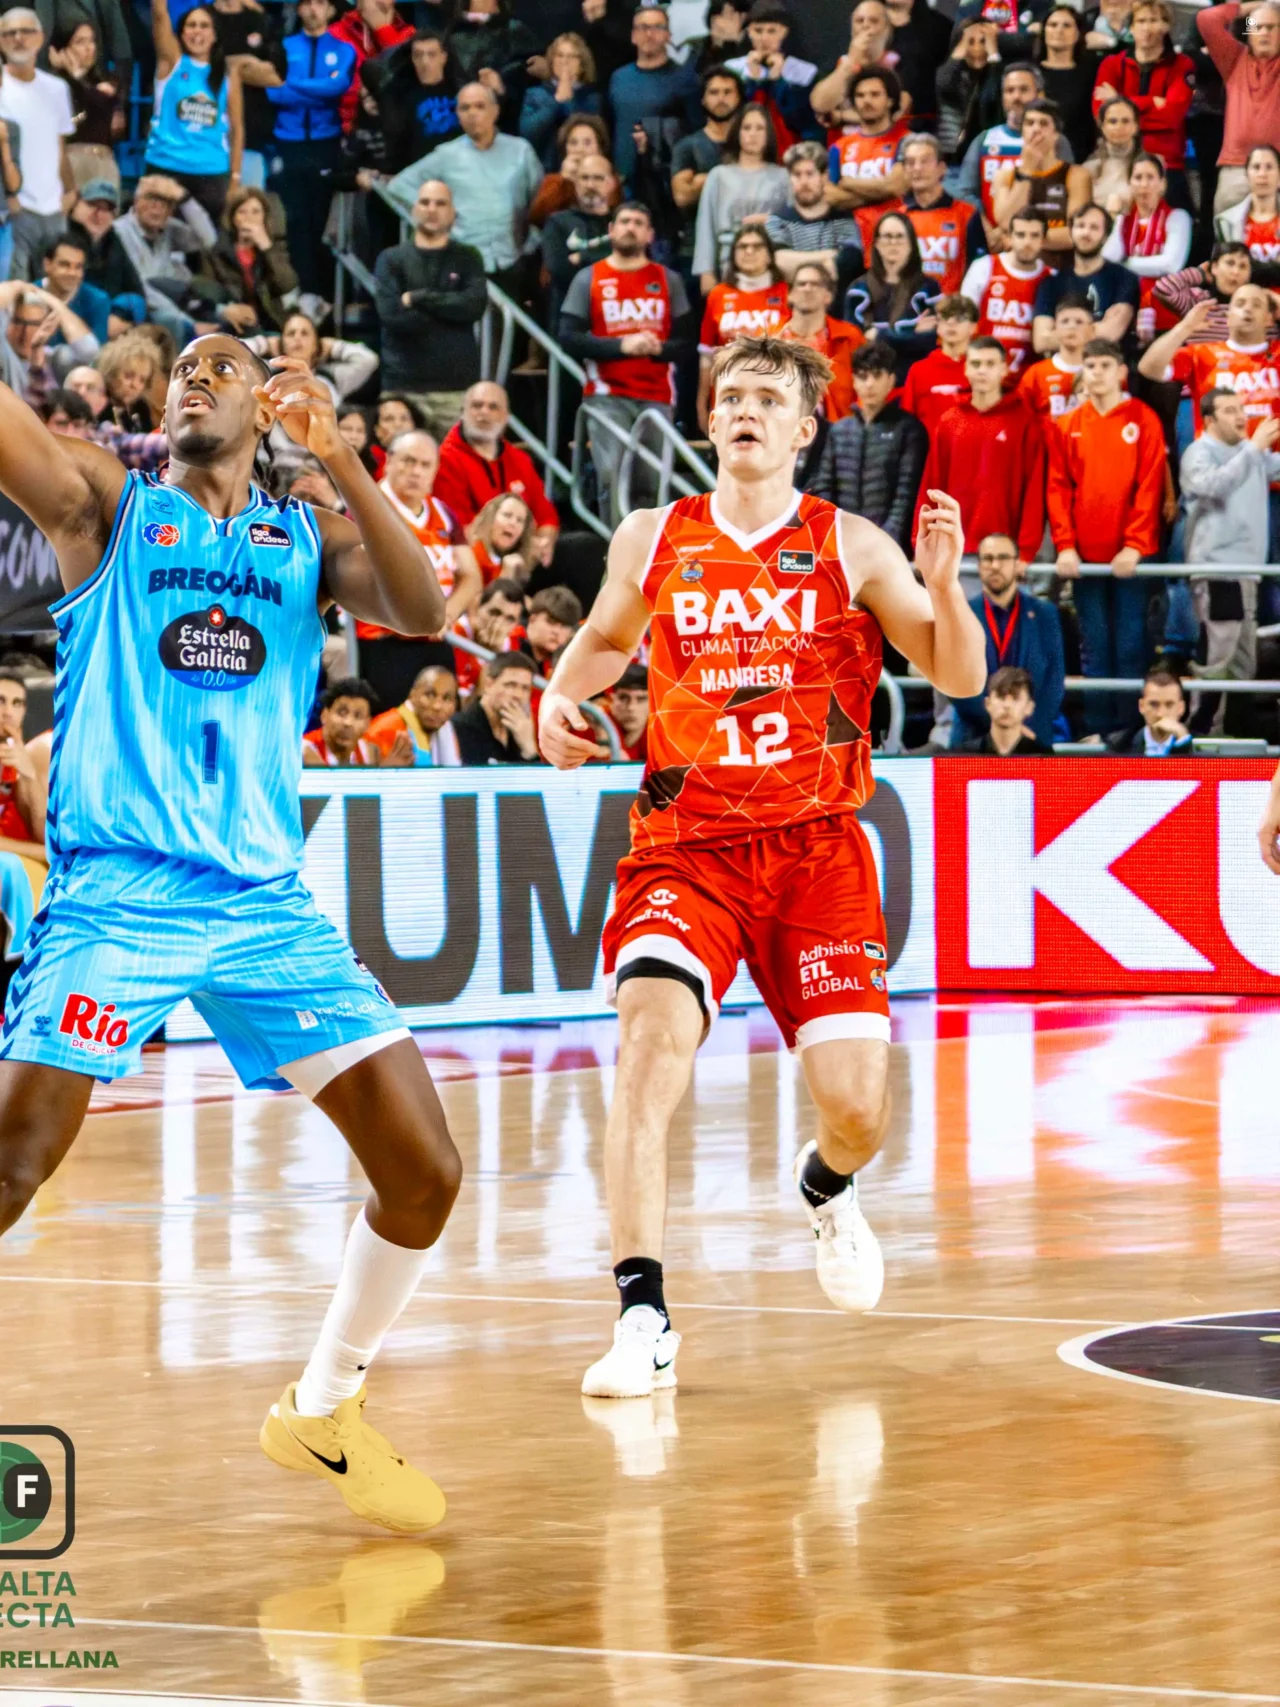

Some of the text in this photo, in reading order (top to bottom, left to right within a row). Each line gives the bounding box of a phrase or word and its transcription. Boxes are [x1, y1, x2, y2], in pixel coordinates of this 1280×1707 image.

[602, 299, 665, 322] BAXI
[720, 310, 781, 332] BAXI
[251, 528, 270, 538] liga
[253, 535, 290, 545] endesa
[147, 566, 283, 608] BREOGÁN
[671, 587, 818, 636] BAXI
[177, 624, 252, 650] Estrella
[180, 645, 248, 671] Galicia
[203, 669, 226, 688] 0,0
[700, 663, 794, 693] MANRESA
[716, 711, 793, 766] 12
[201, 719, 220, 784] 1
[800, 960, 834, 985] ETL
[802, 976, 865, 1000] GLOBAL
[72, 1039, 85, 1049] DE
